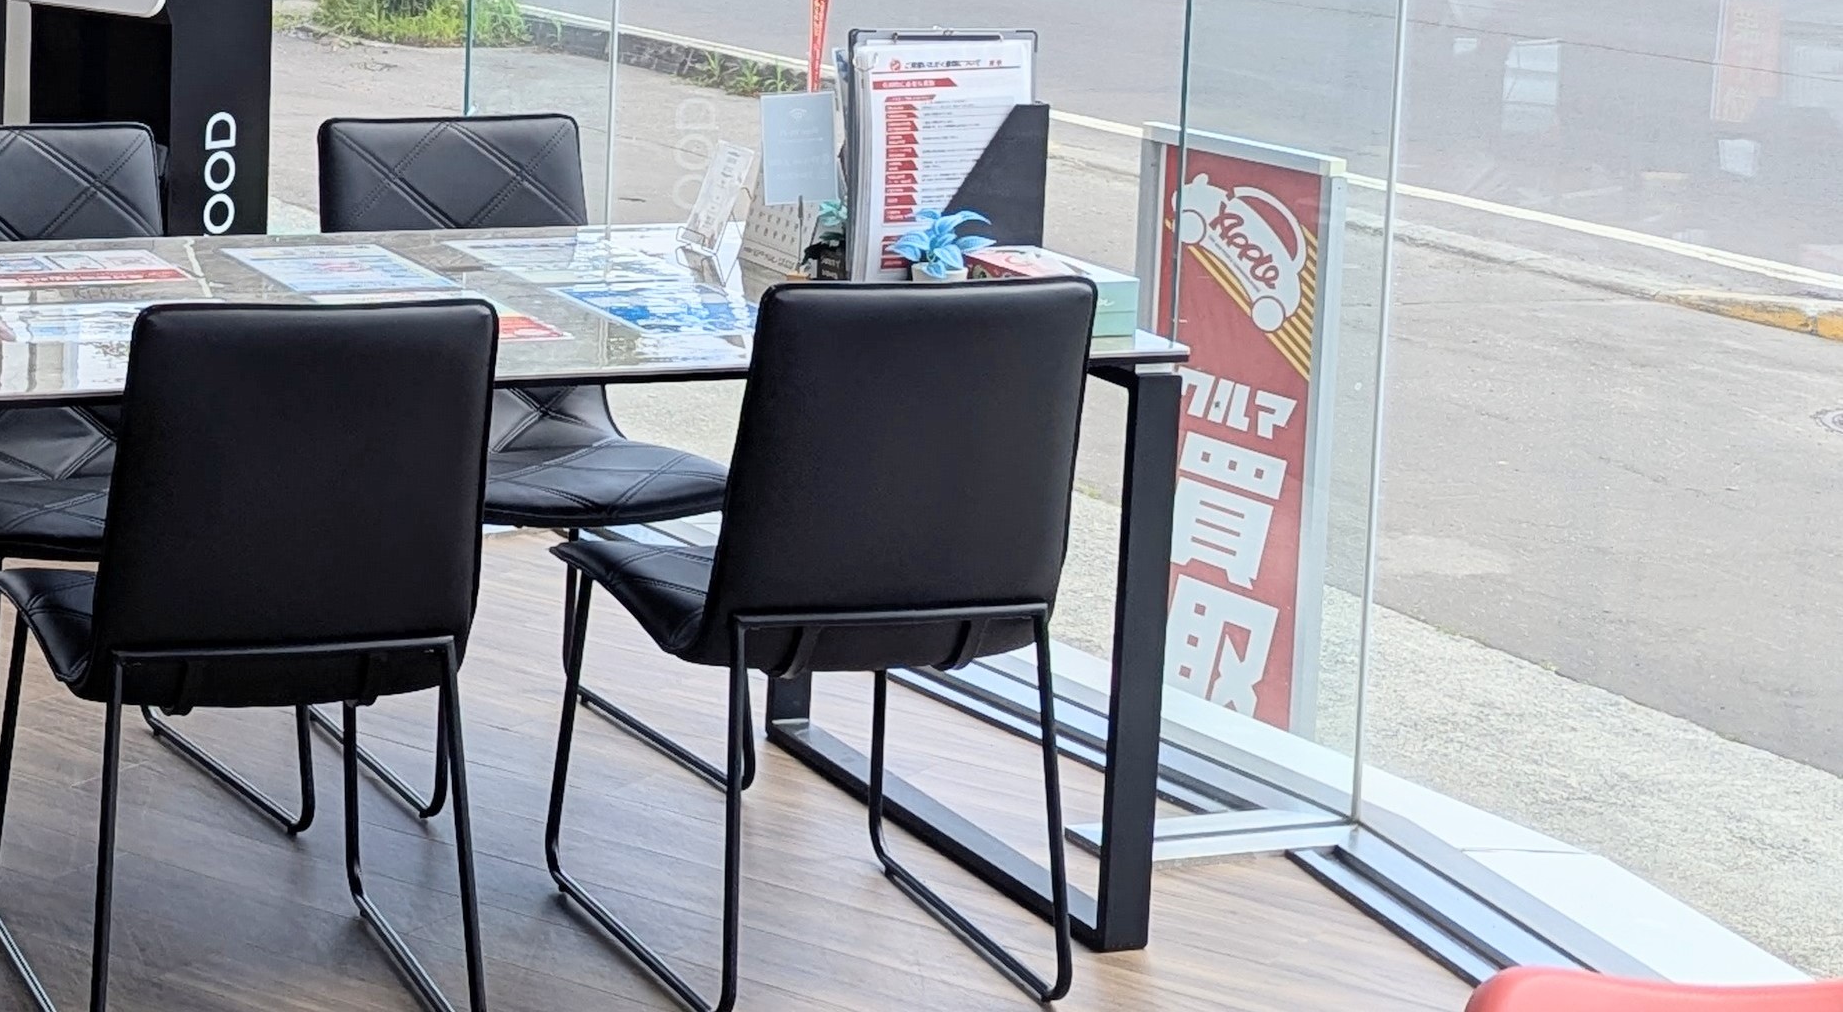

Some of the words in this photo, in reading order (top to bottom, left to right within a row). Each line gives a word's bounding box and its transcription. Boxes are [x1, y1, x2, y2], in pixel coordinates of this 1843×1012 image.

[1177, 367, 1298, 440] クルマ
[1166, 430, 1289, 721] 買取
